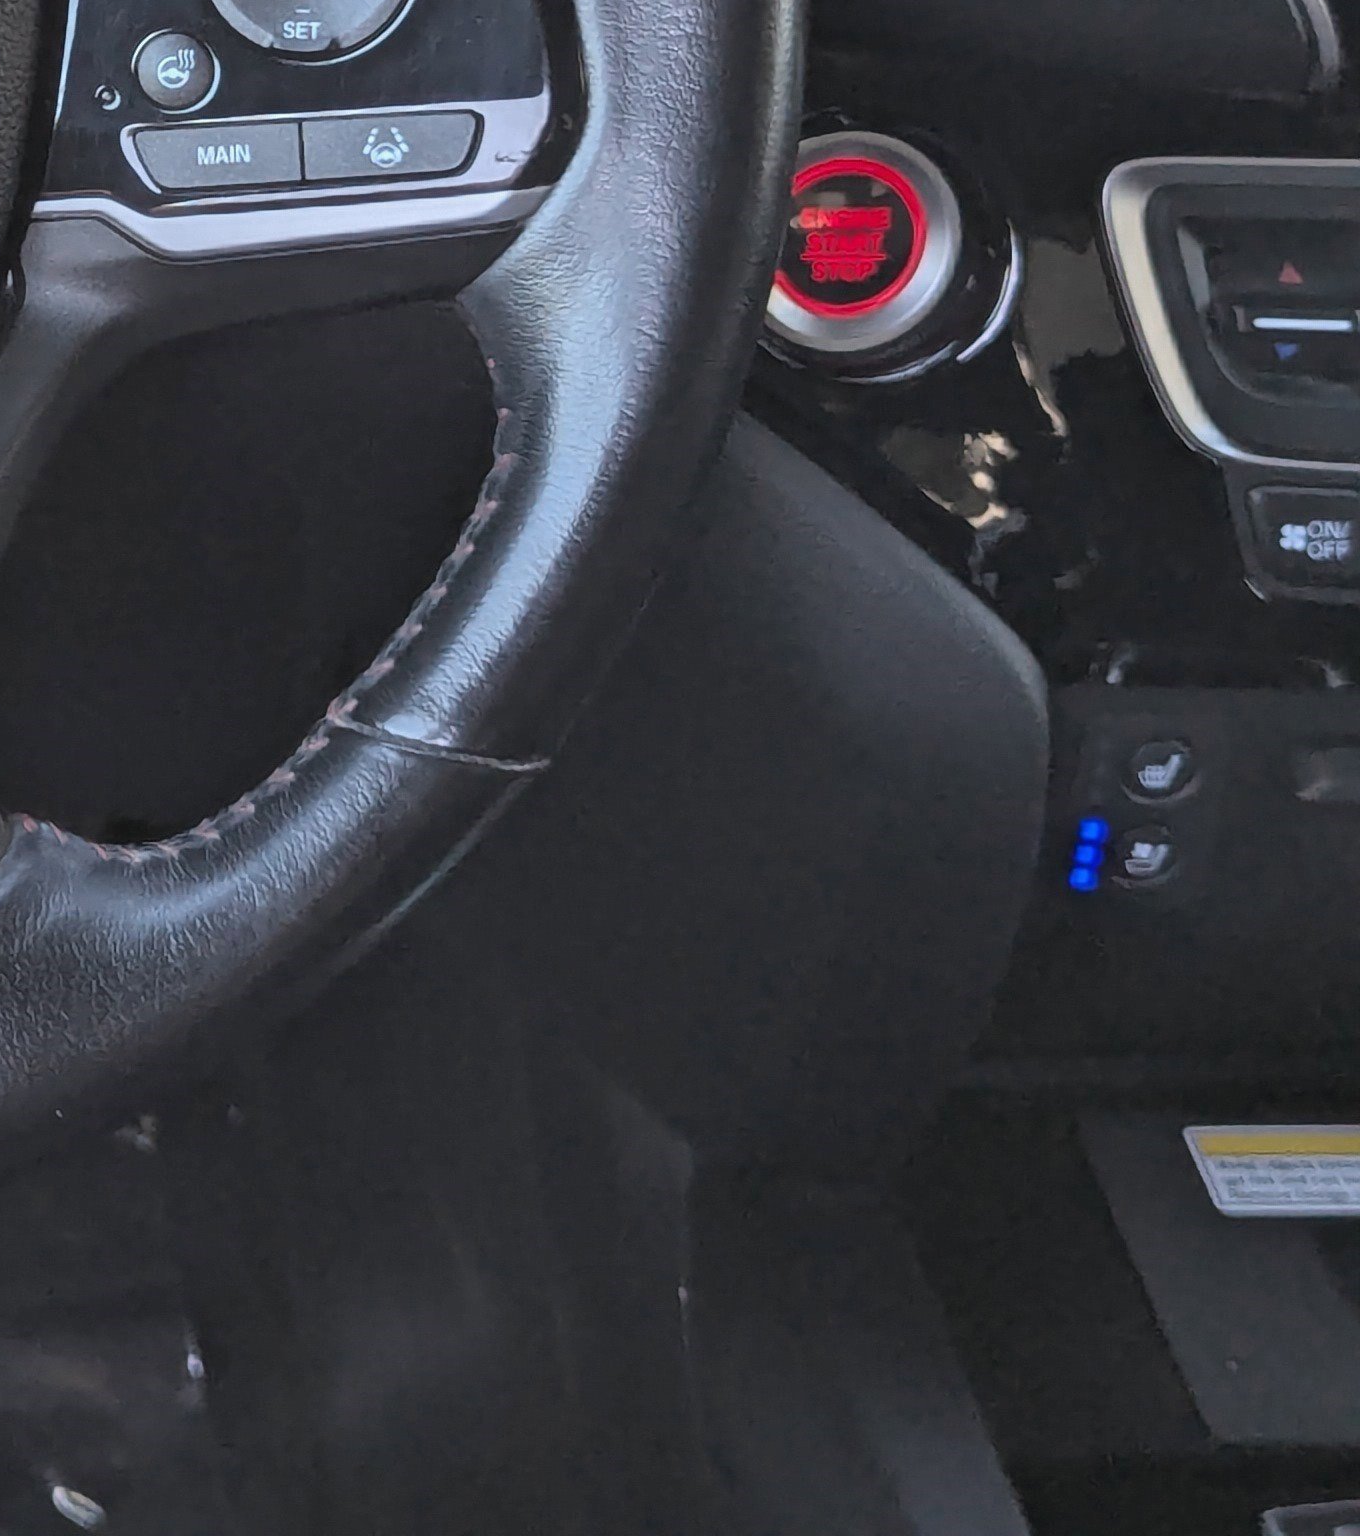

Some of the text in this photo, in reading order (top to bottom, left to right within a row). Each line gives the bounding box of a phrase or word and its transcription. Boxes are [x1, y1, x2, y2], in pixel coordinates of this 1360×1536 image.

[283, 21, 321, 40] SET
[197, 145, 250, 167] MAIN
[812, 262, 877, 282] STOP
